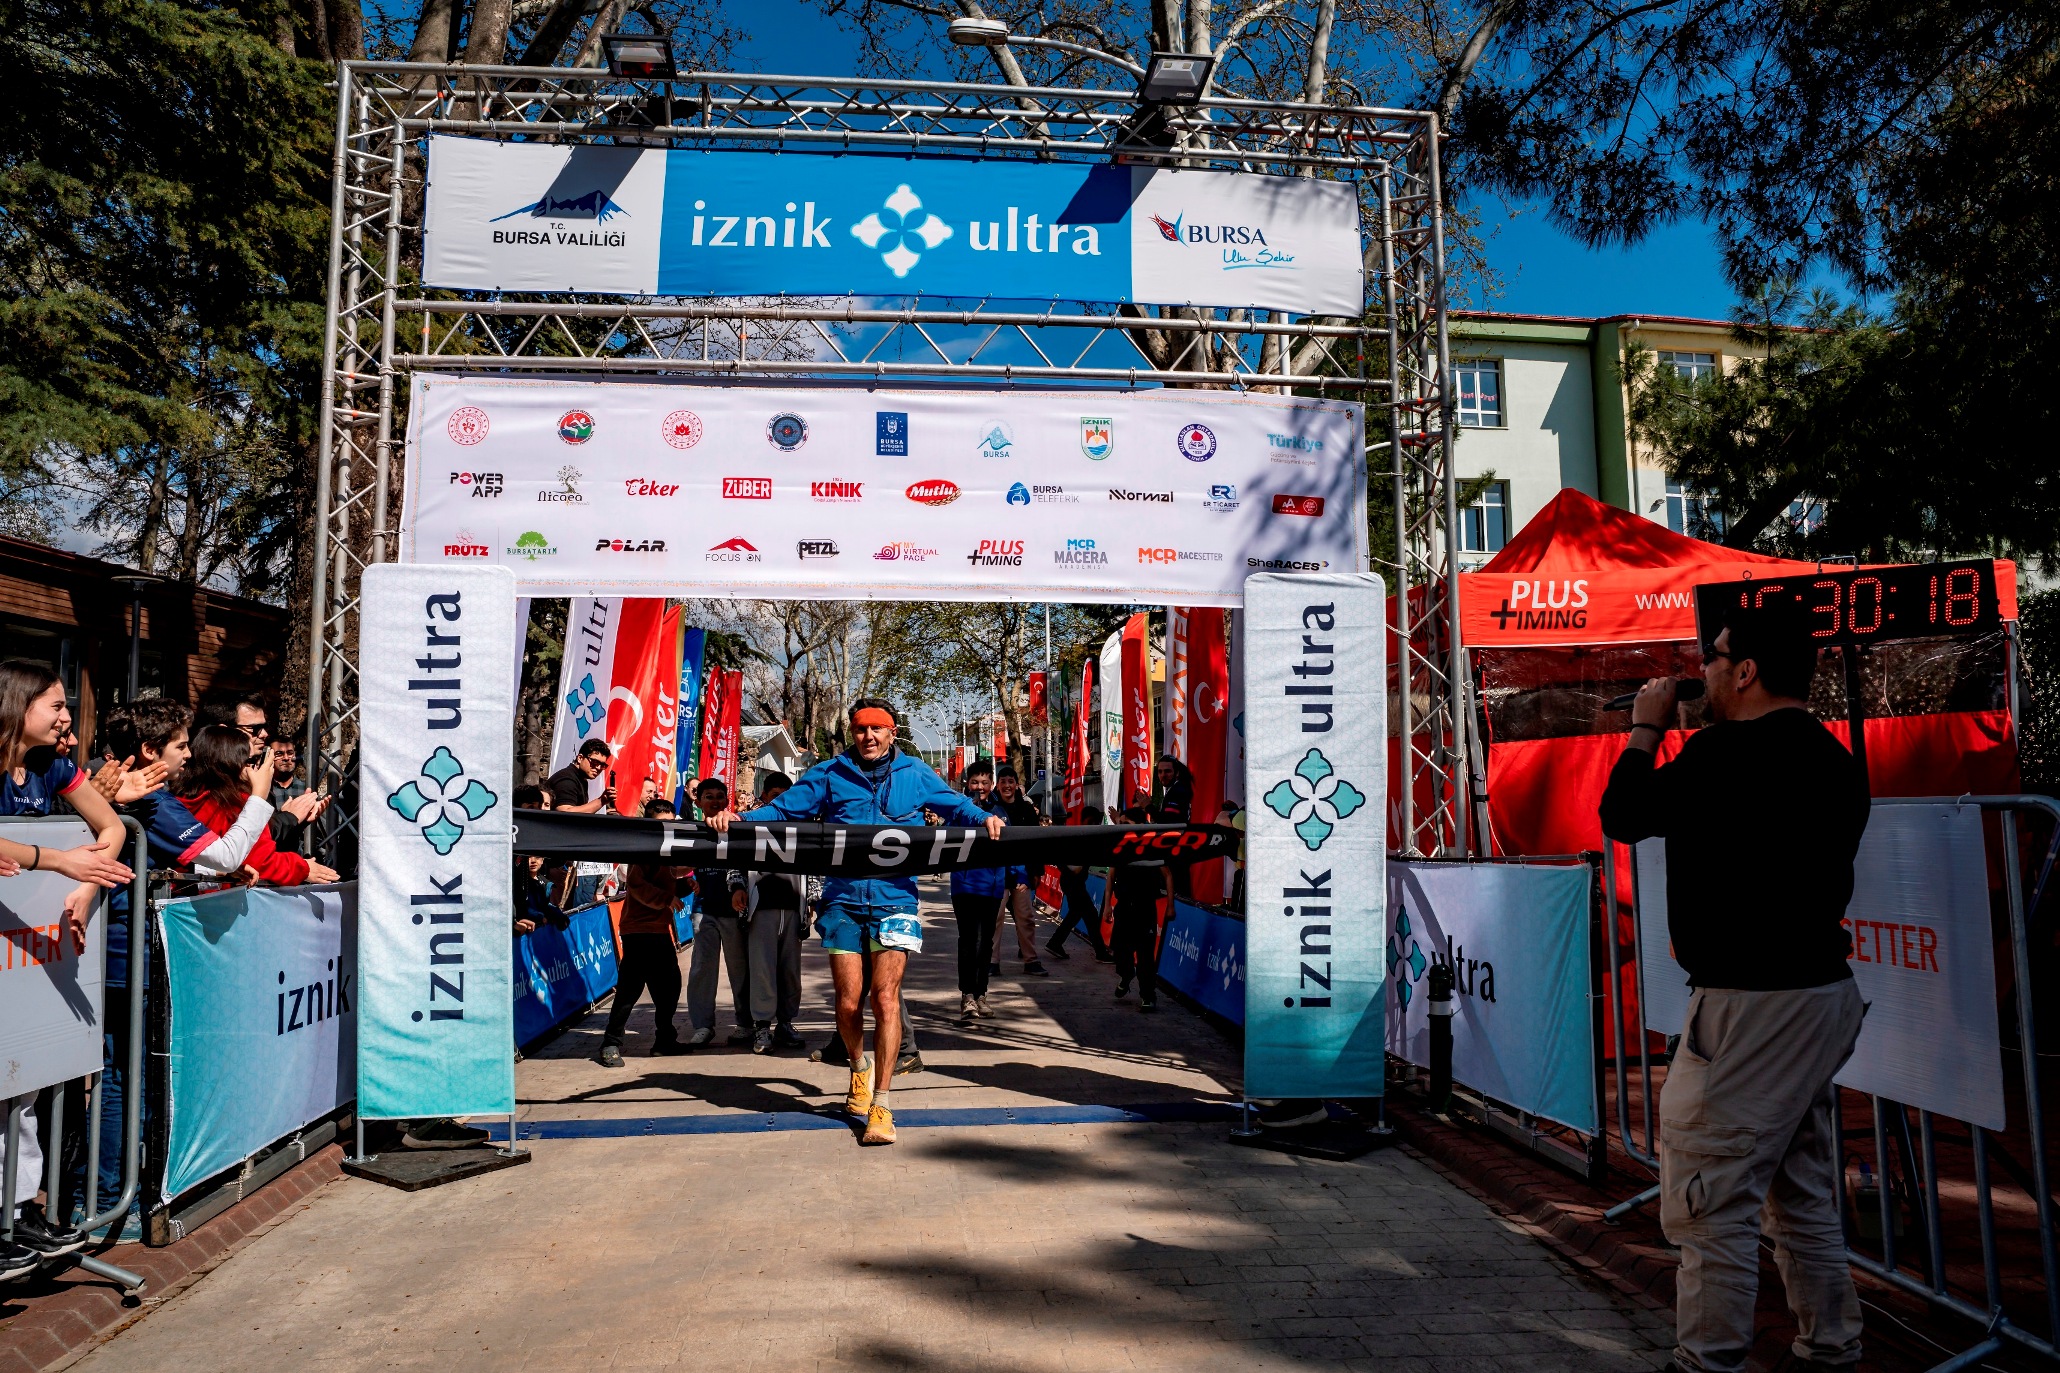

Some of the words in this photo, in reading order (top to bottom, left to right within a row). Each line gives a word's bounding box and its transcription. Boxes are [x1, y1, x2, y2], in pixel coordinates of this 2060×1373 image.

[550, 222, 566, 230] T.C.
[691, 200, 833, 248] iznik
[969, 206, 1102, 256] ultra
[493, 230, 552, 246] BURSA
[556, 230, 626, 247] VALİLİĞİ
[1188, 225, 1267, 247] BURSA
[1267, 433, 1324, 453] Türkiye
[450, 472, 504, 486] POWER
[472, 485, 503, 498] APP
[626, 478, 680, 497] Teker
[909, 483, 954, 498] Mutlu
[1033, 485, 1063, 494] BURSA
[1109, 488, 1174, 503] Normal
[1033, 494, 1080, 504] TELEFERİK
[444, 544, 489, 557] FRUTZ
[596, 539, 665, 552] POLAR
[797, 540, 840, 560] PETZL
[904, 541, 916, 549] MY
[904, 548, 939, 556] VIRTUAL
[979, 539, 1025, 555] PLUS
[1067, 538, 1096, 551] MCR
[705, 553, 741, 562] FOCUS
[746, 554, 761, 562] ON
[1054, 550, 1109, 564] MACERA
[1138, 547, 1177, 565] MCR
[1178, 551, 1223, 562] RACESETTER
[1247, 557, 1321, 571] SheRACES
[1510, 579, 1589, 610] PLUS
[1634, 592, 1694, 612] www.
[408, 590, 463, 730] ultra
[1284, 602, 1336, 734] ultra
[659, 819, 979, 869] FINISH
[903, 920, 912, 933] 2
[1282, 868, 1333, 1009] iznik
[0, 923, 63, 972] TTER
[411, 873, 465, 1023] iznik
[549, 957, 570, 984] ultra
[277, 954, 352, 1038] iznik
